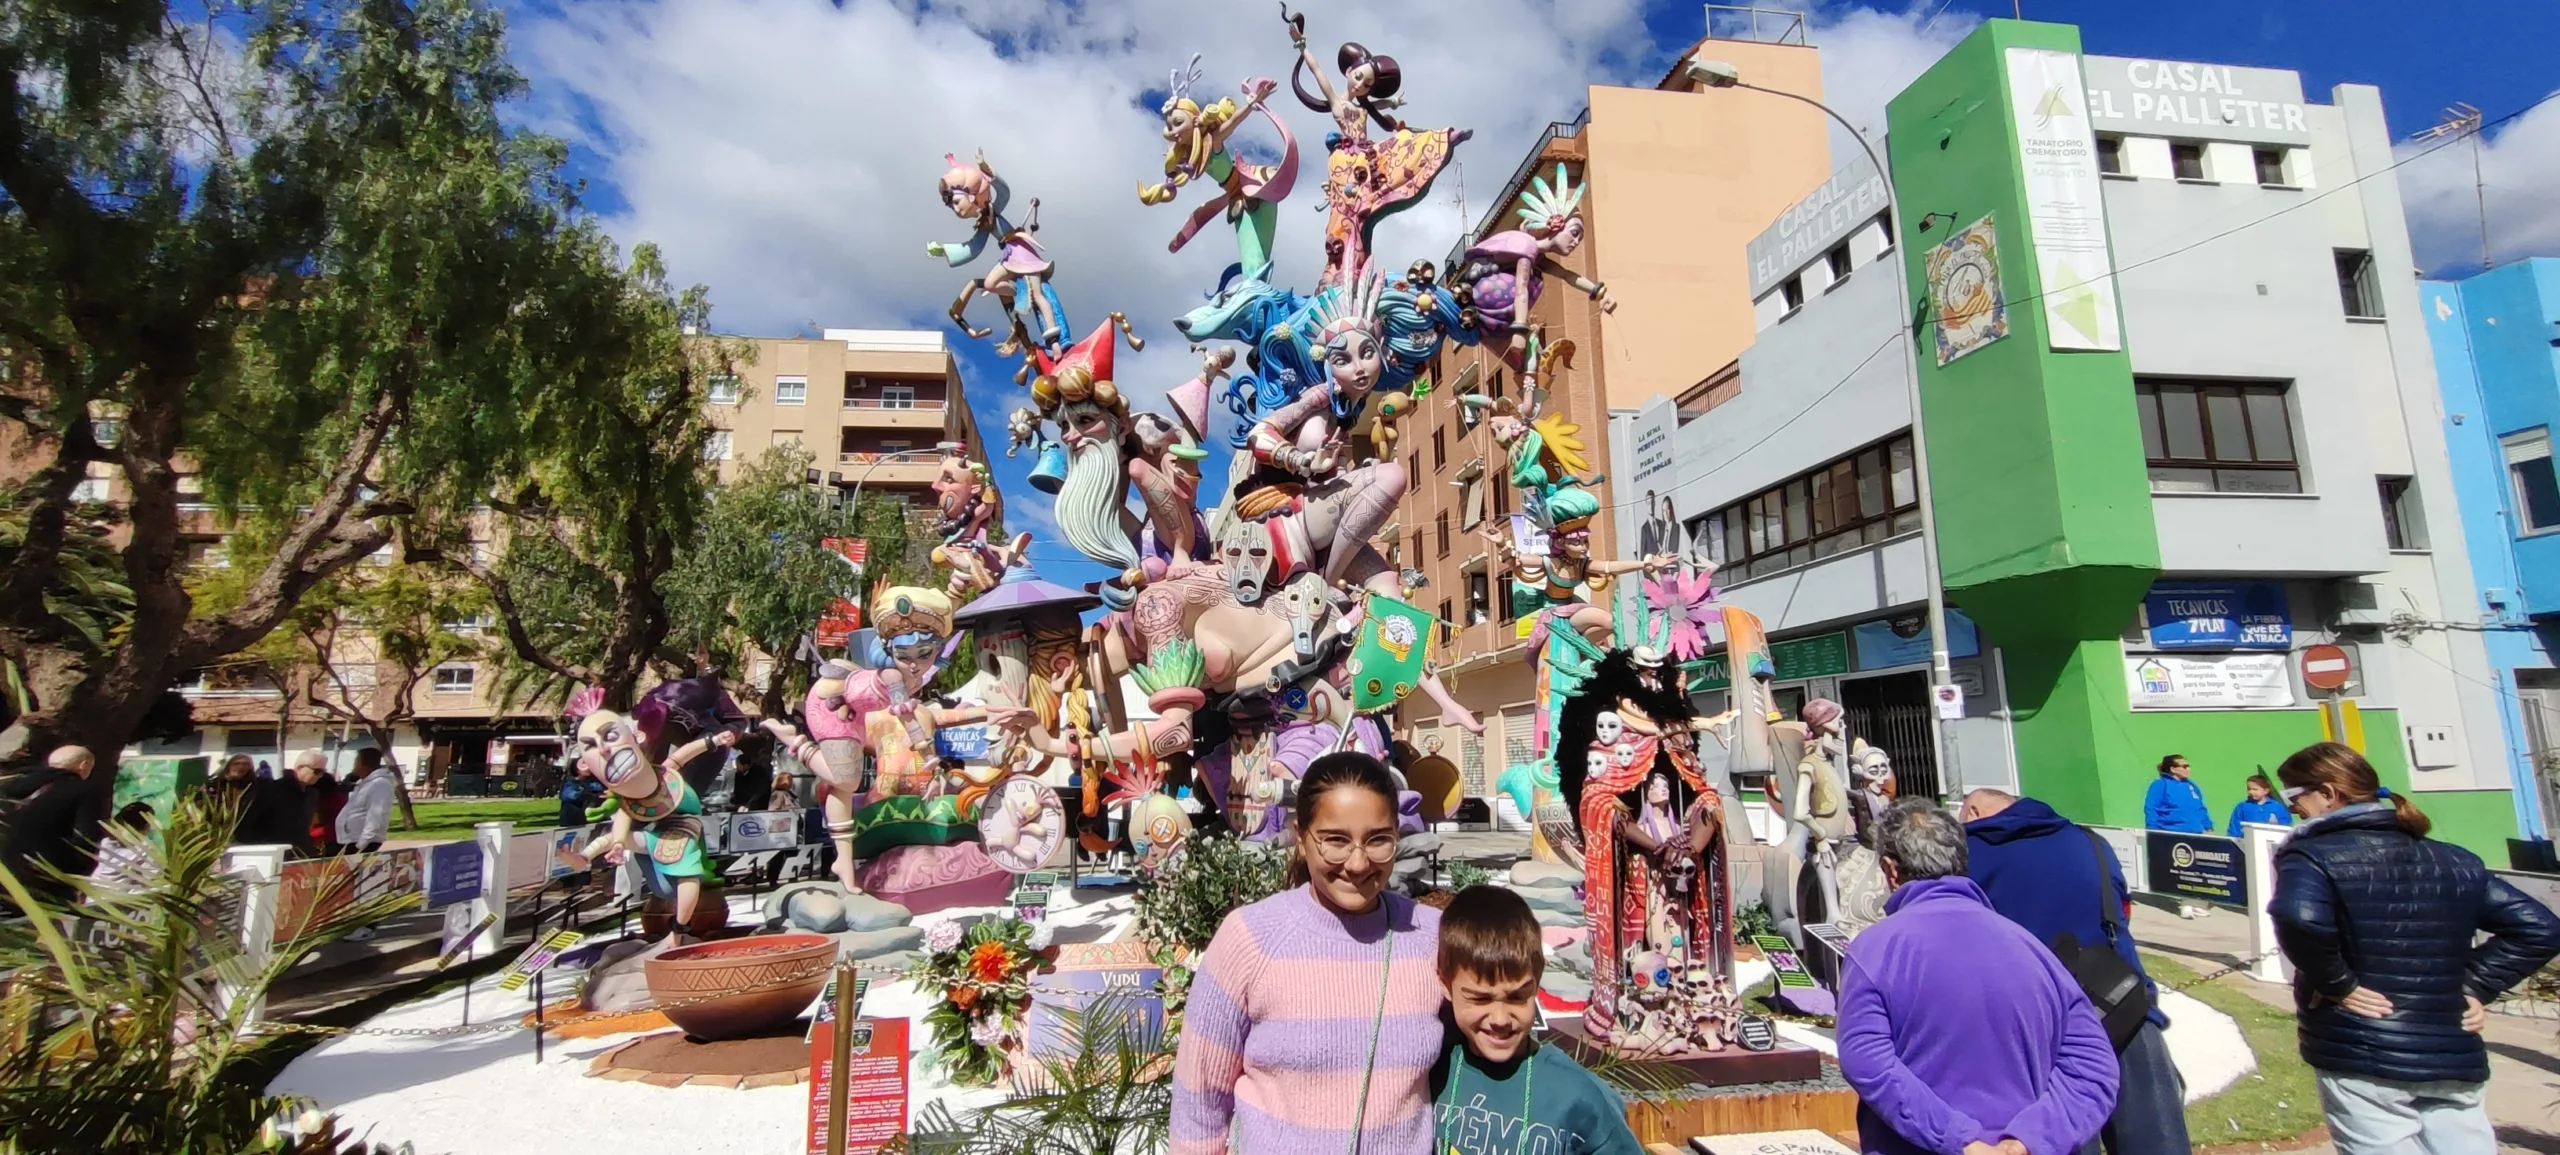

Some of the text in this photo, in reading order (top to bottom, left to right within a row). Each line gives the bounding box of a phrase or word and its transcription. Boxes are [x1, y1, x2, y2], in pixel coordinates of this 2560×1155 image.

[2127, 60, 2243, 95] CASAL
[2088, 89, 2307, 132] EL PALLETER
[2026, 139, 2083, 148] TANATORIO
[2025, 148, 2087, 157] CREMATORIO
[1779, 176, 1846, 239] CASAL
[1757, 173, 1888, 285] EL PALLETER
[2167, 600, 2229, 616] TECAVICAS
[2254, 615, 2283, 624] FIBRA
[2244, 624, 2282, 635] QUE ES
[2254, 634, 2289, 643] TRACA
[1699, 661, 1731, 681] BAN
[941, 731, 980, 741] TECAVICAS
